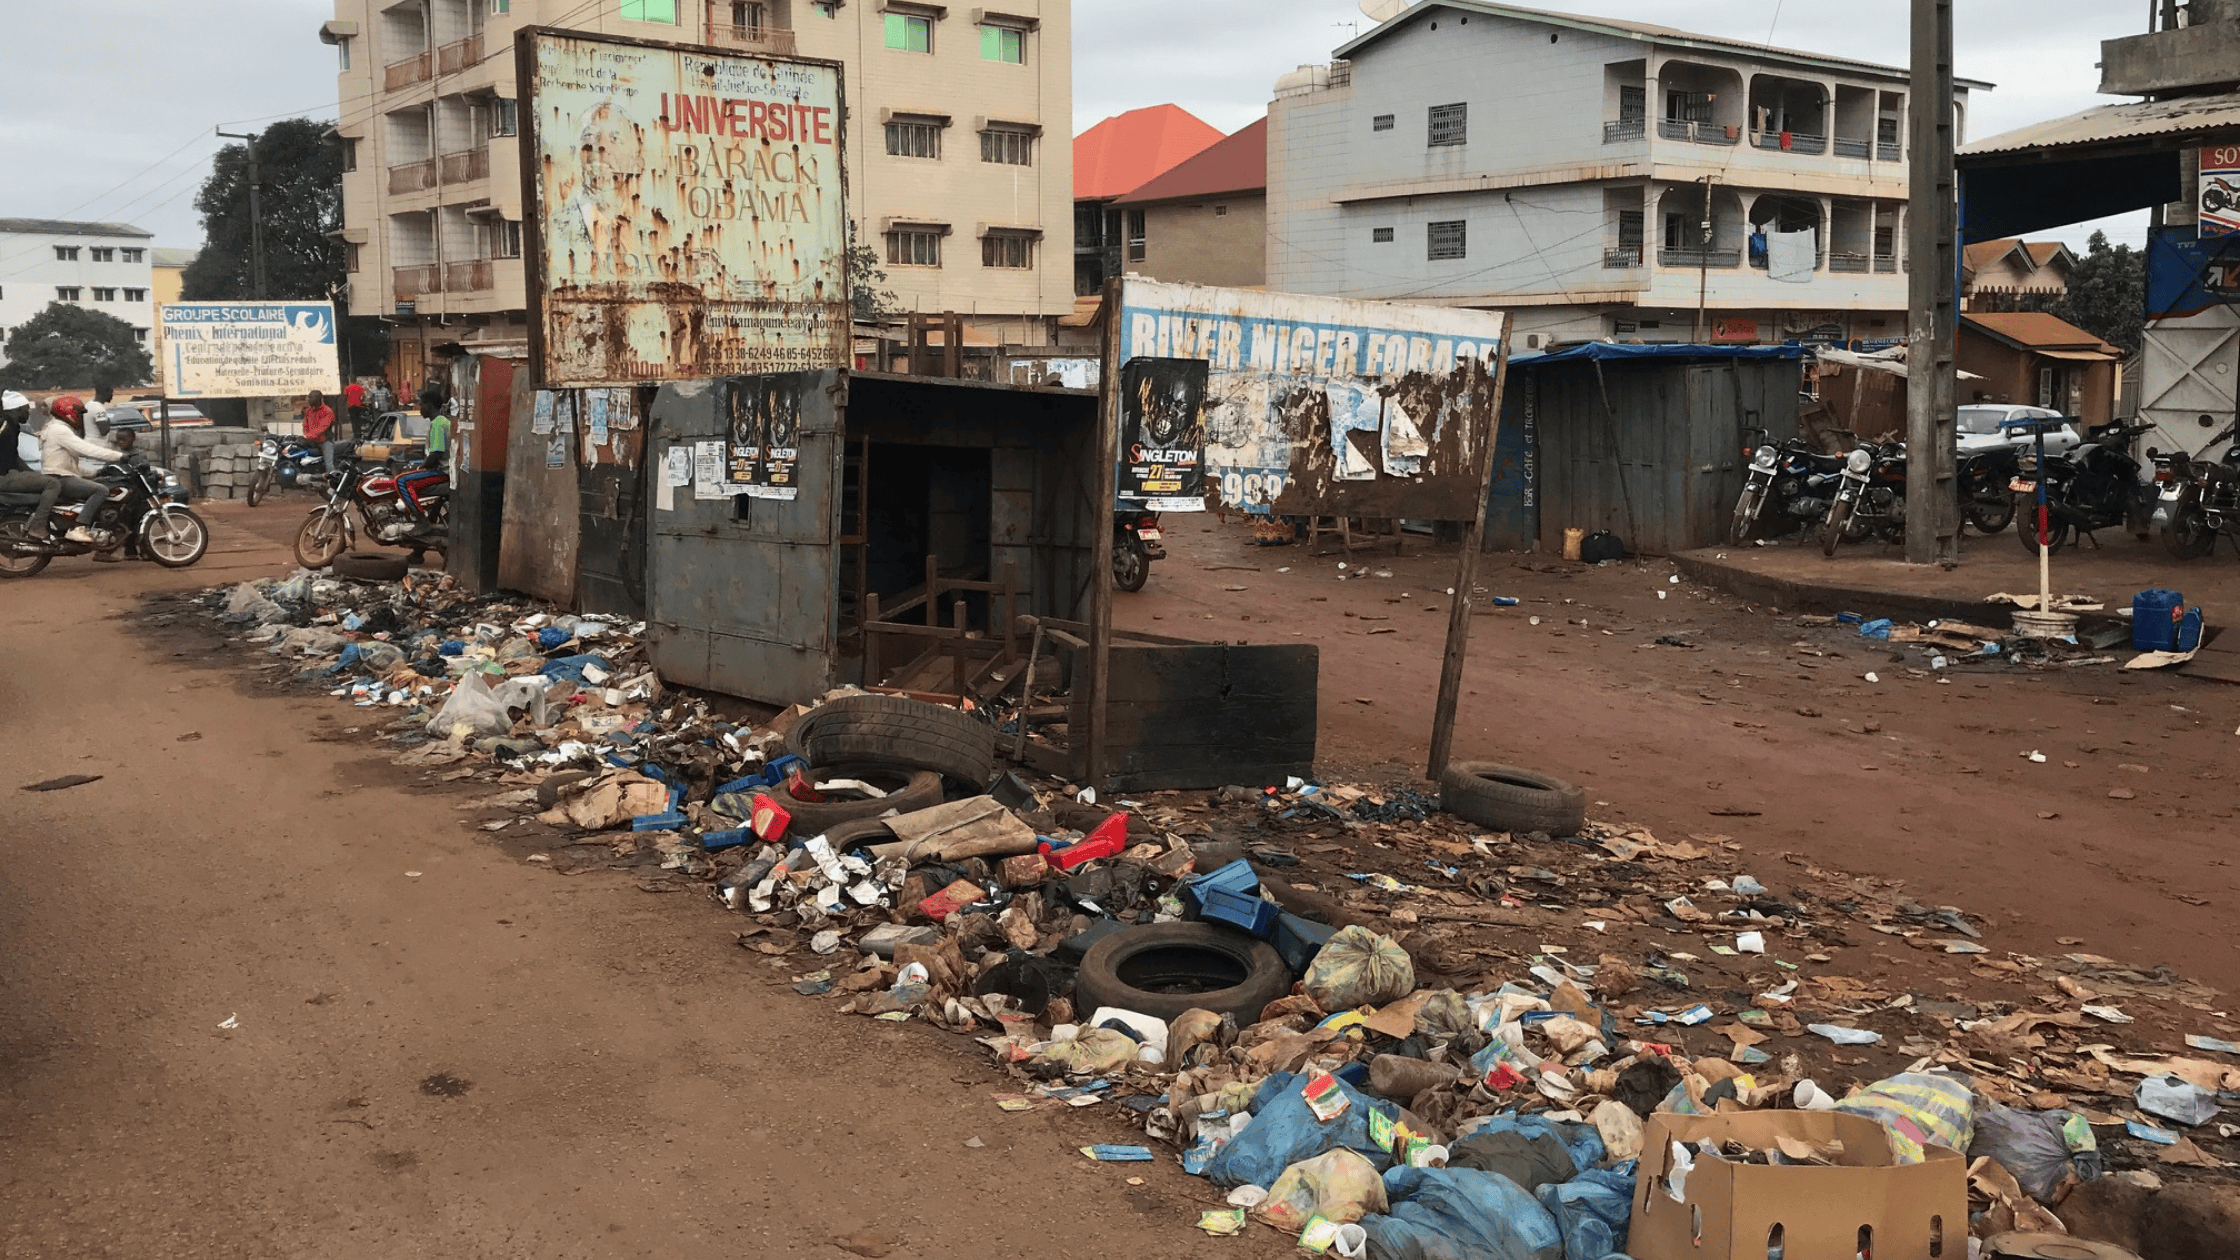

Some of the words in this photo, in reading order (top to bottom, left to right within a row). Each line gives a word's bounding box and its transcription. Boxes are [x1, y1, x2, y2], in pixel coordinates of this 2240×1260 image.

[661, 93, 832, 145] UNIVERSITE
[676, 143, 819, 185] BARACK
[2213, 147, 2240, 166] SO
[688, 185, 811, 225] OBAMA
[163, 308, 220, 321] GROUPE
[221, 307, 284, 320] SCOLAIRE
[1131, 312, 1241, 368] RIVER
[1251, 323, 1358, 377] NIGER
[1129, 443, 1198, 464] SINGLETON
[1148, 464, 1163, 480] 27
